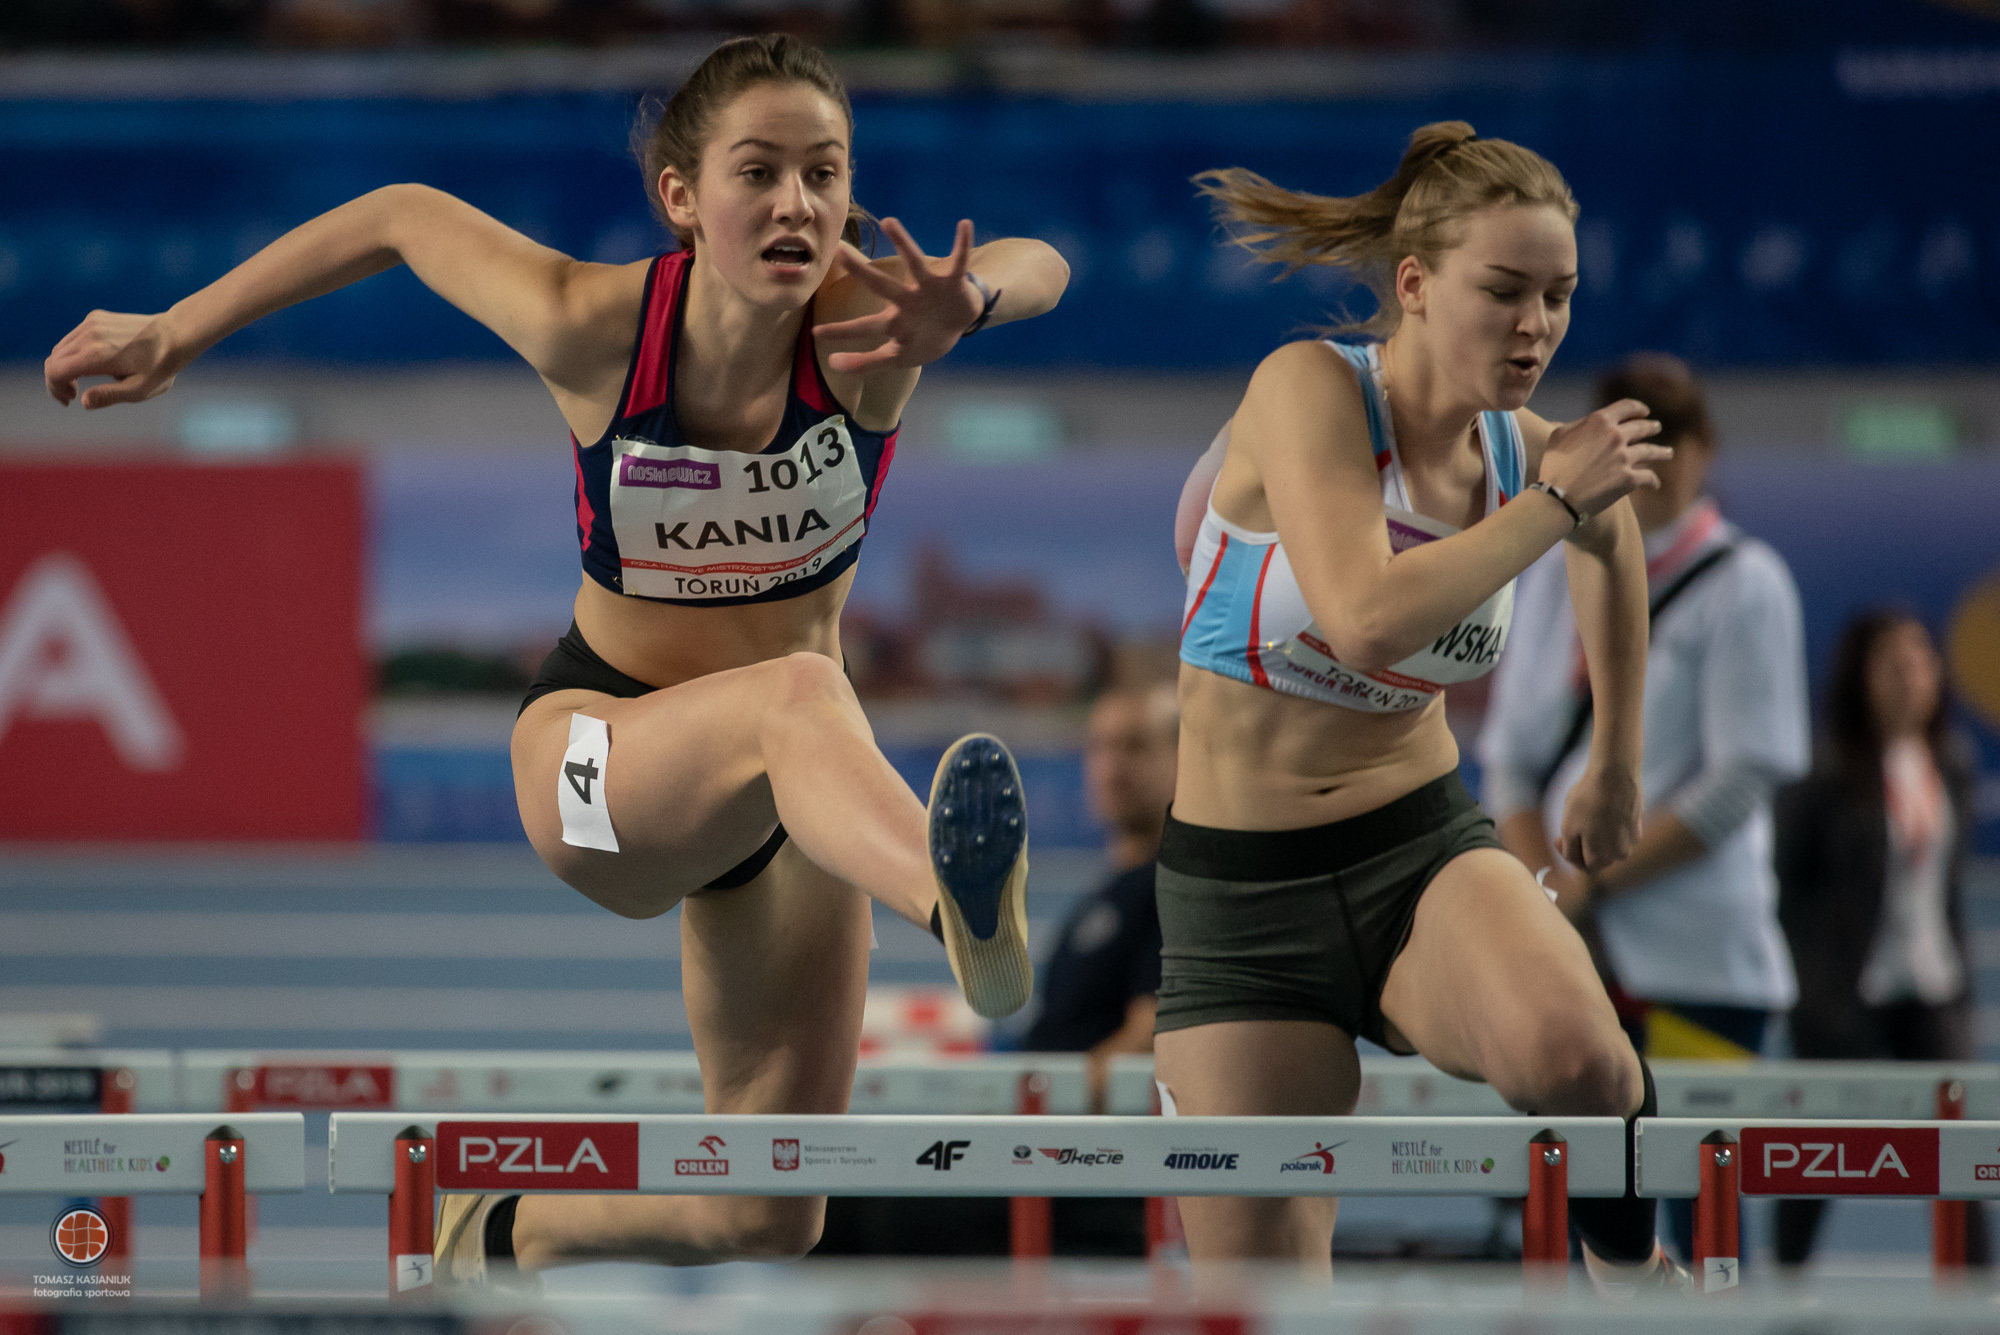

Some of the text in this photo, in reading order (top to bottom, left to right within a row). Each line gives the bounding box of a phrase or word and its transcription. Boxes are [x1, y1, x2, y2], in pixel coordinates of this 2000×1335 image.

[743, 426, 846, 493] 1013
[654, 508, 831, 550] KANIA
[674, 557, 822, 595] TORUŃ 2019
[564, 757, 599, 805] 4
[63, 1156, 154, 1173] HEALTHIER KIDS
[459, 1136, 609, 1174] PZLA
[676, 1160, 727, 1175] ORLEN
[916, 1140, 972, 1171] 4F
[1164, 1153, 1240, 1170] 4MOVE
[1280, 1160, 1322, 1174] polanik
[1391, 1158, 1479, 1175] HEALTHIER KIDS
[1763, 1142, 1910, 1179] PZLA
[1977, 1166, 2000, 1179] OR
